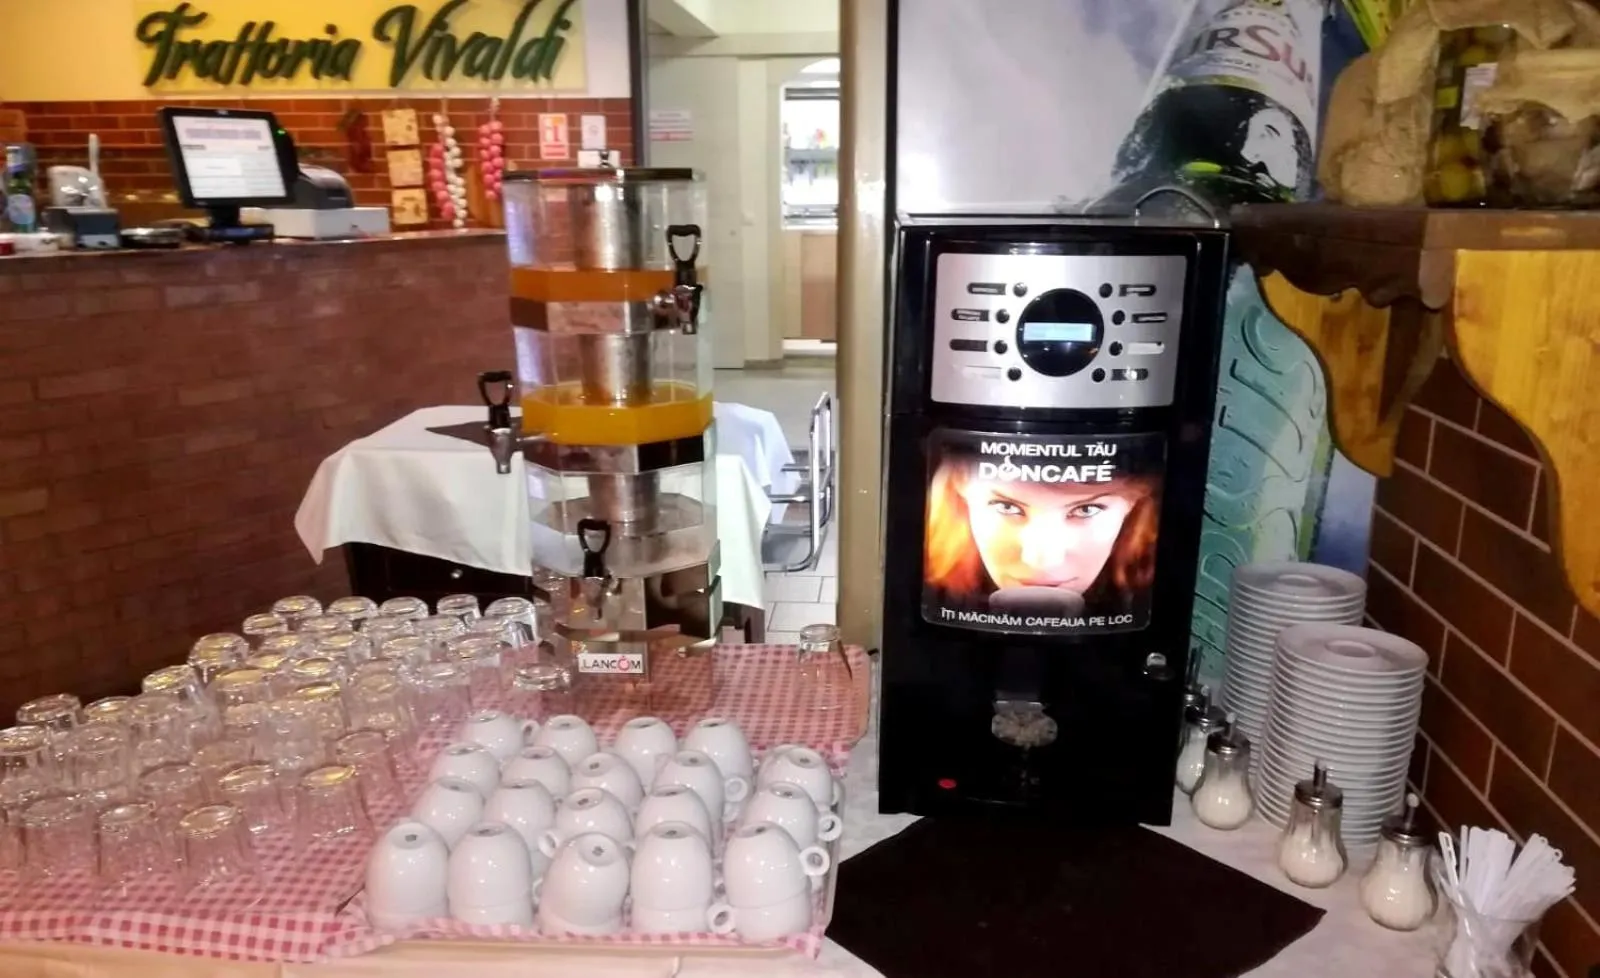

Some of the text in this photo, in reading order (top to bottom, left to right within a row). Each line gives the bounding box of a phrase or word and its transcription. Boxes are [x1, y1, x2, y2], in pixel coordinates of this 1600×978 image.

[136, 0, 574, 87] Trattoria Vivaldi
[1190, 24, 1314, 83] RSU
[981, 442, 1117, 457] MOMENTUL TĂU
[979, 458, 1114, 483] DONCAFÉ
[959, 611, 1022, 626] MĂCINĂM
[1025, 616, 1086, 627] CAFEAUA
[1089, 616, 1105, 626] PE
[1108, 614, 1133, 625] LOC
[583, 656, 641, 671] LANCOM
